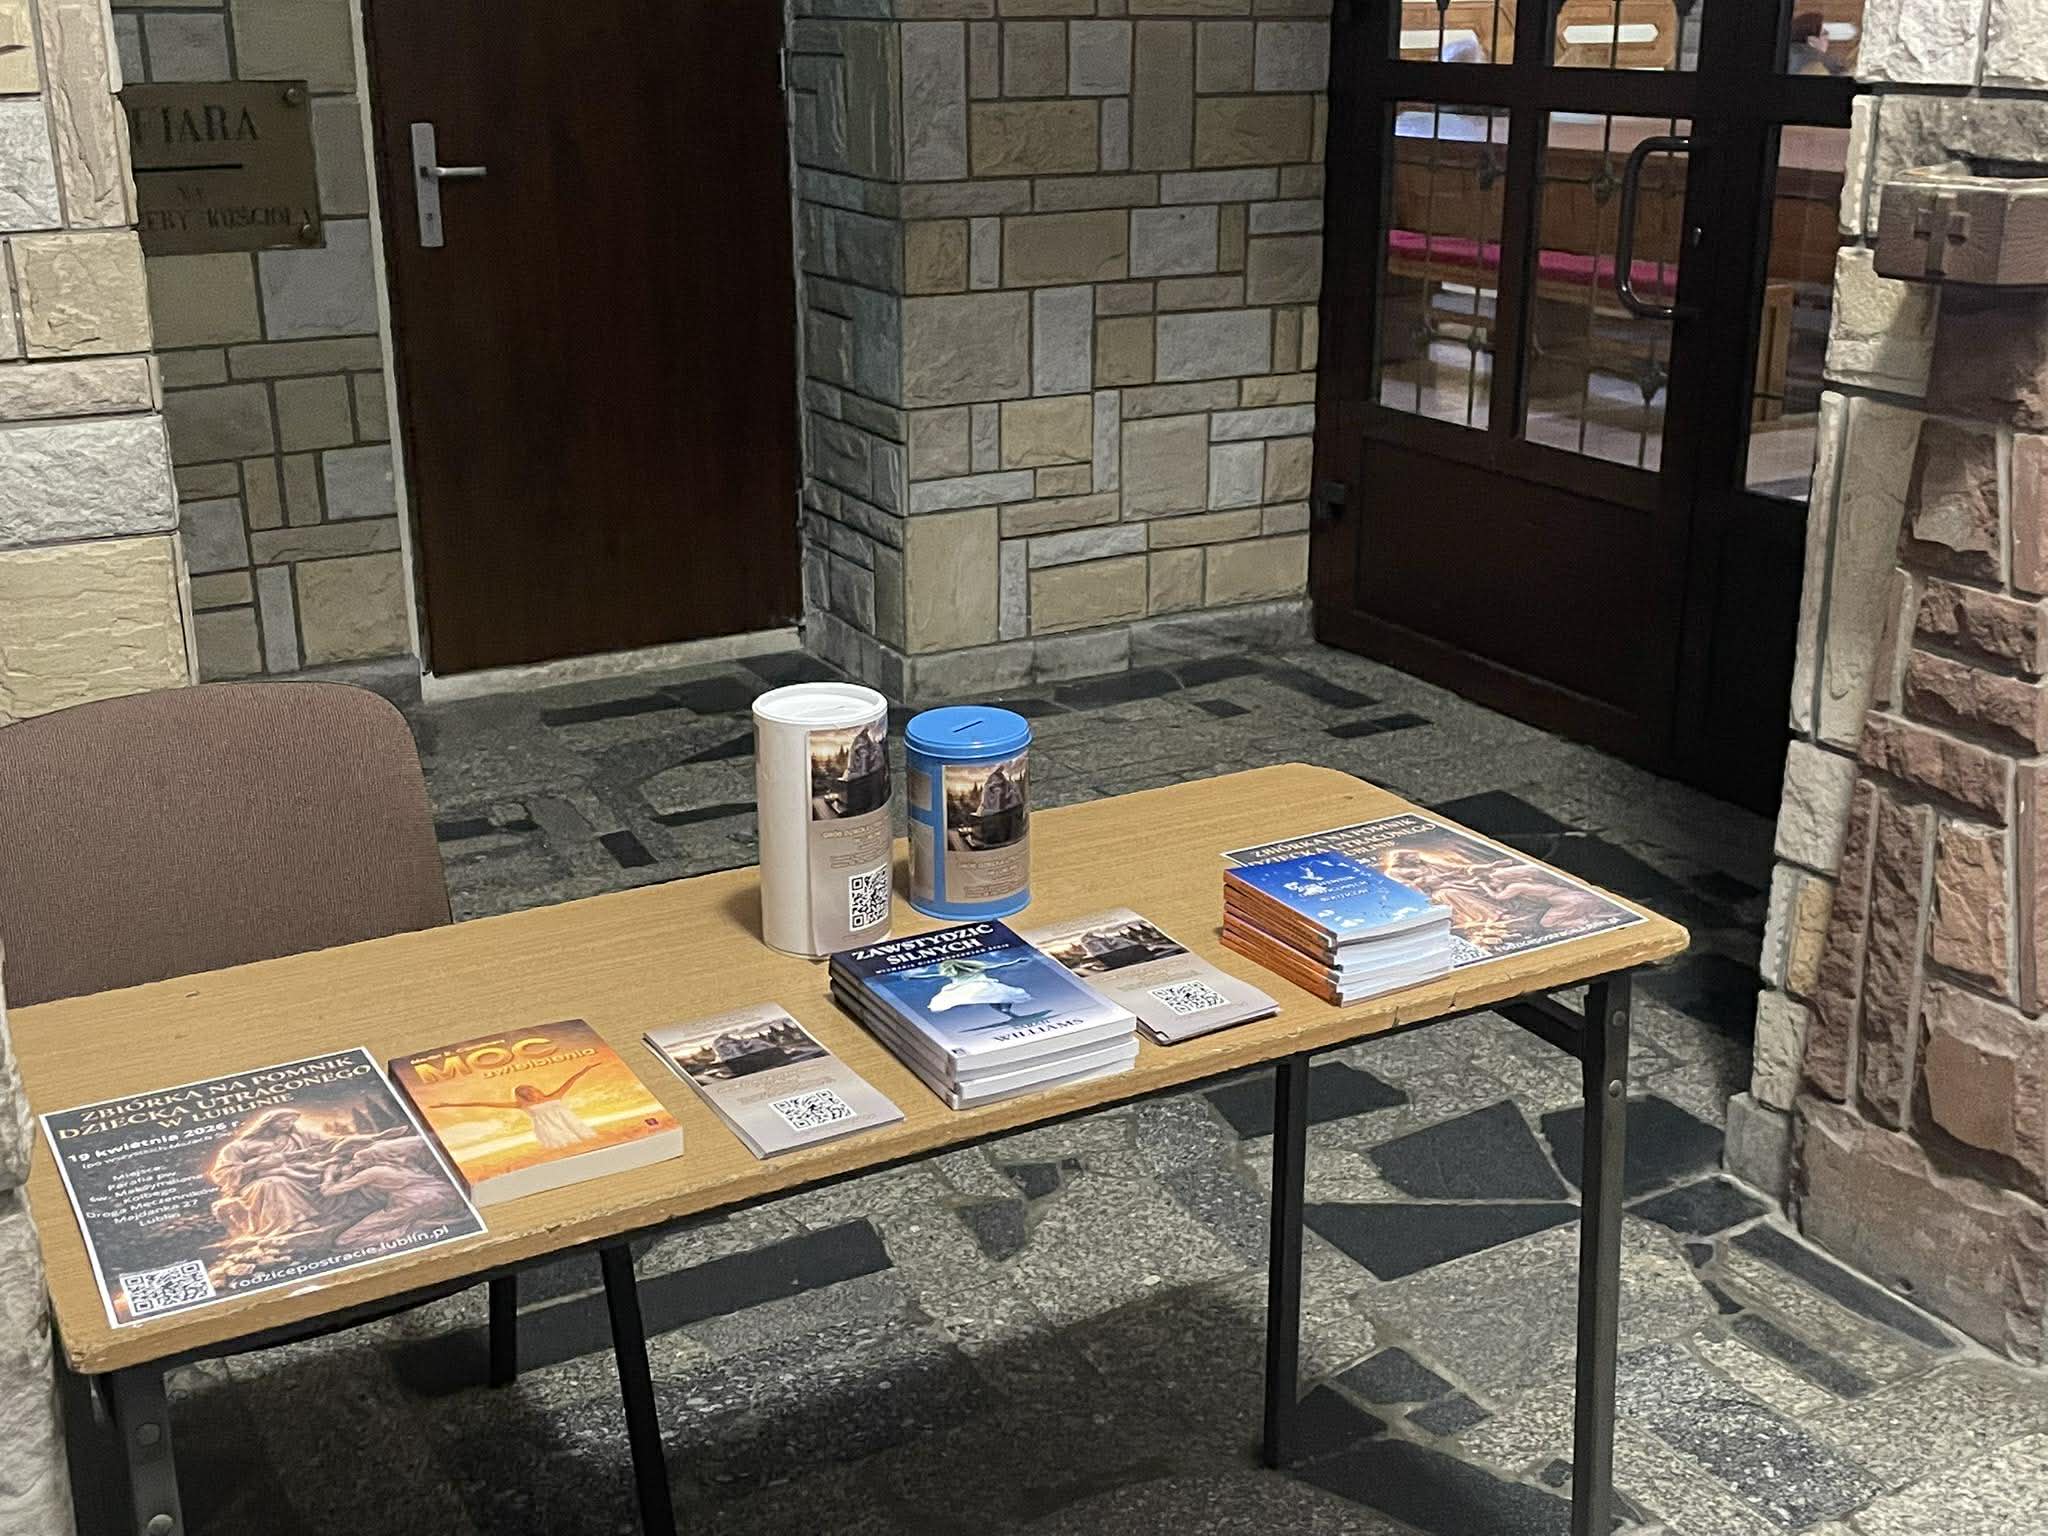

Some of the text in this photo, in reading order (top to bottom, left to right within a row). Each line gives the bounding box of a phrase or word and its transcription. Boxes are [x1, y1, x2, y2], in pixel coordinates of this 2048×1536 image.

[131, 104, 258, 143] FIARA
[886, 938, 984, 965] SILNYCH
[993, 1019, 1084, 1042] WILLIAMS
[414, 1037, 557, 1084] MOC
[58, 1065, 371, 1139] DZIECKA UTRACONEGO
[80, 1056, 353, 1123] ZBIÓRKA NA POMNIK
[157, 1092, 294, 1128] W LUBLINIE
[67, 1153, 90, 1163] 19
[95, 1134, 179, 1159] kwietnia
[183, 1123, 227, 1139] 2026
[229, 1224, 449, 1290] rodzicepostracie.lublin.pl
